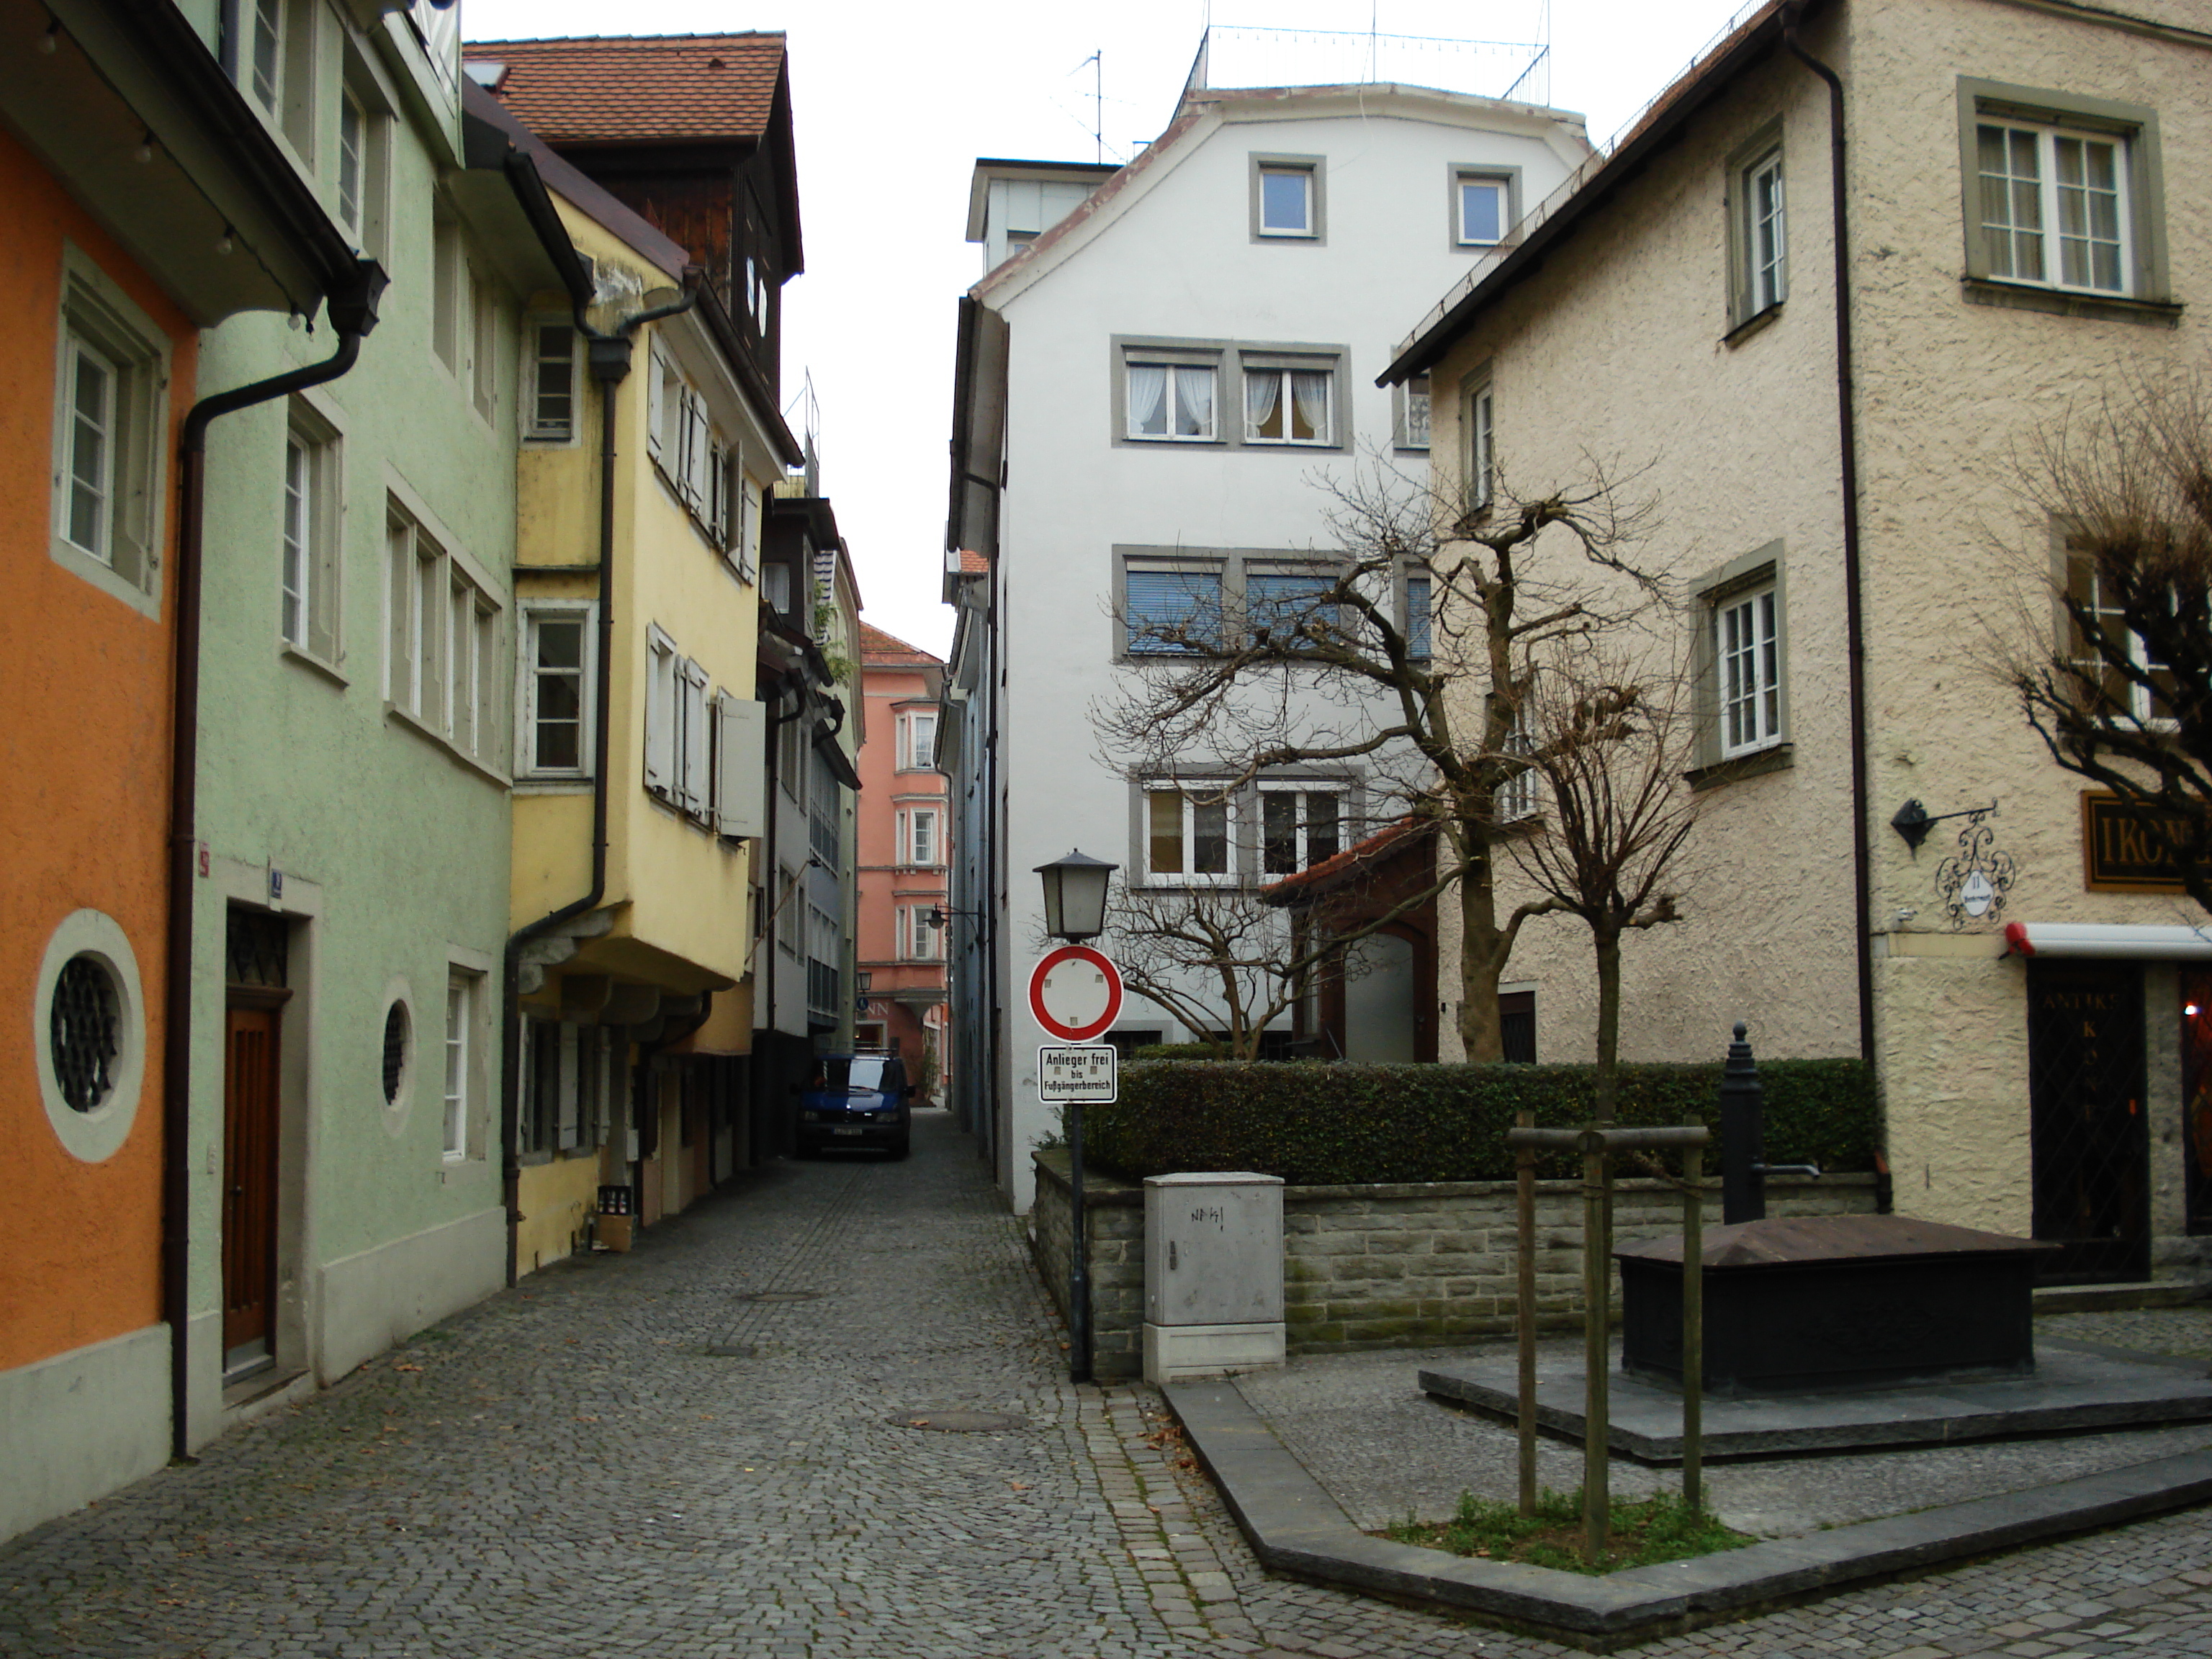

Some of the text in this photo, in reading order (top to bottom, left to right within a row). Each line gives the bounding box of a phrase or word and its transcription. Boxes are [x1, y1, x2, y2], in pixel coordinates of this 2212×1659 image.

[1046, 1053, 1108, 1068] Anlieger frei
[1044, 1080, 1110, 1092] Fußgängerbereich
